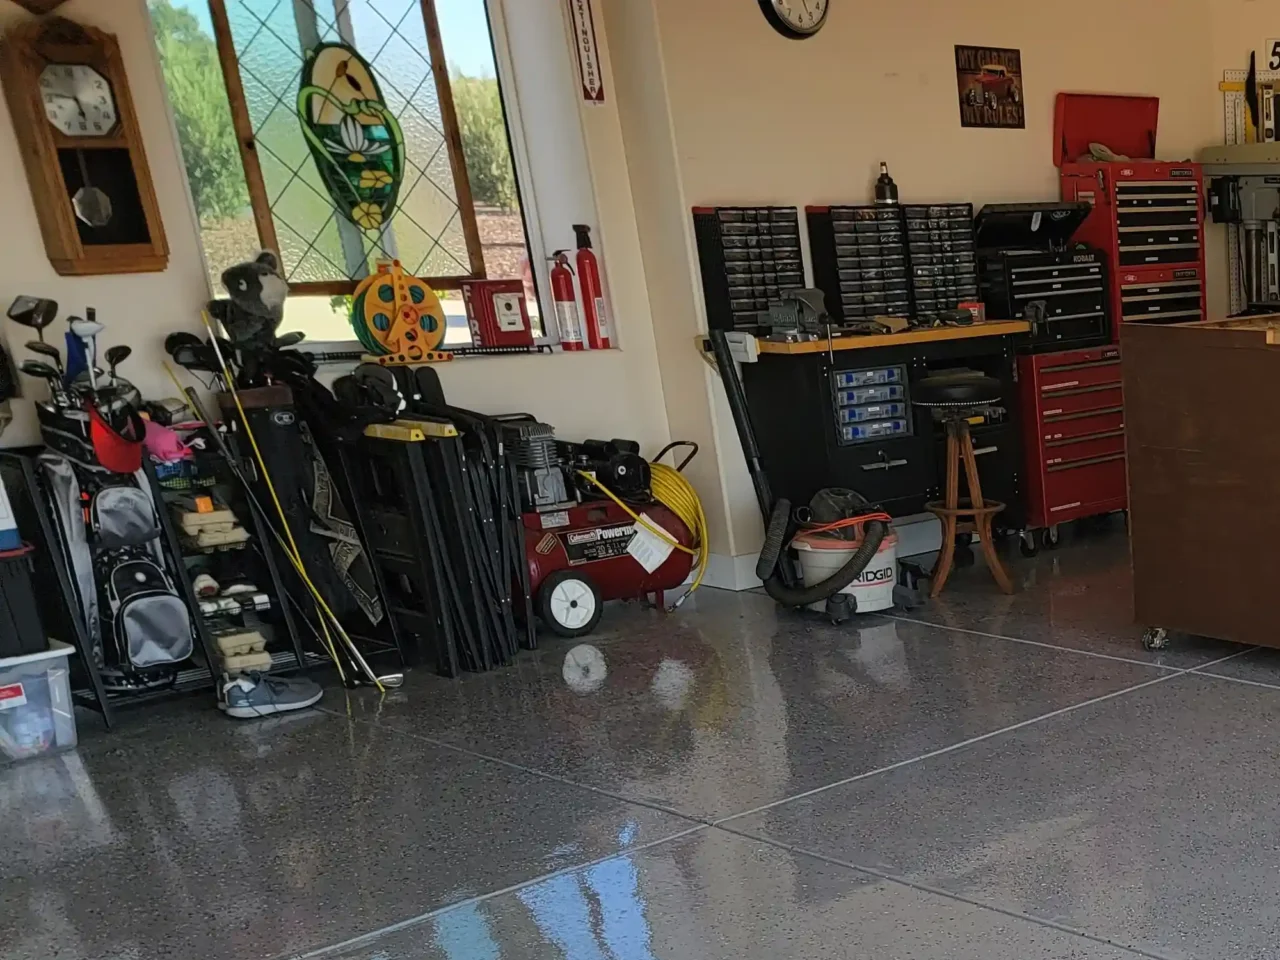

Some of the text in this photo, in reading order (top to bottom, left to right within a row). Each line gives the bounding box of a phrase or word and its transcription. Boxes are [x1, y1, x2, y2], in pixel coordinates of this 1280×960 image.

[577, 0, 597, 93] XTINGUISHER
[1073, 254, 1095, 262] KOBALT
[463, 285, 482, 348] FIRE
